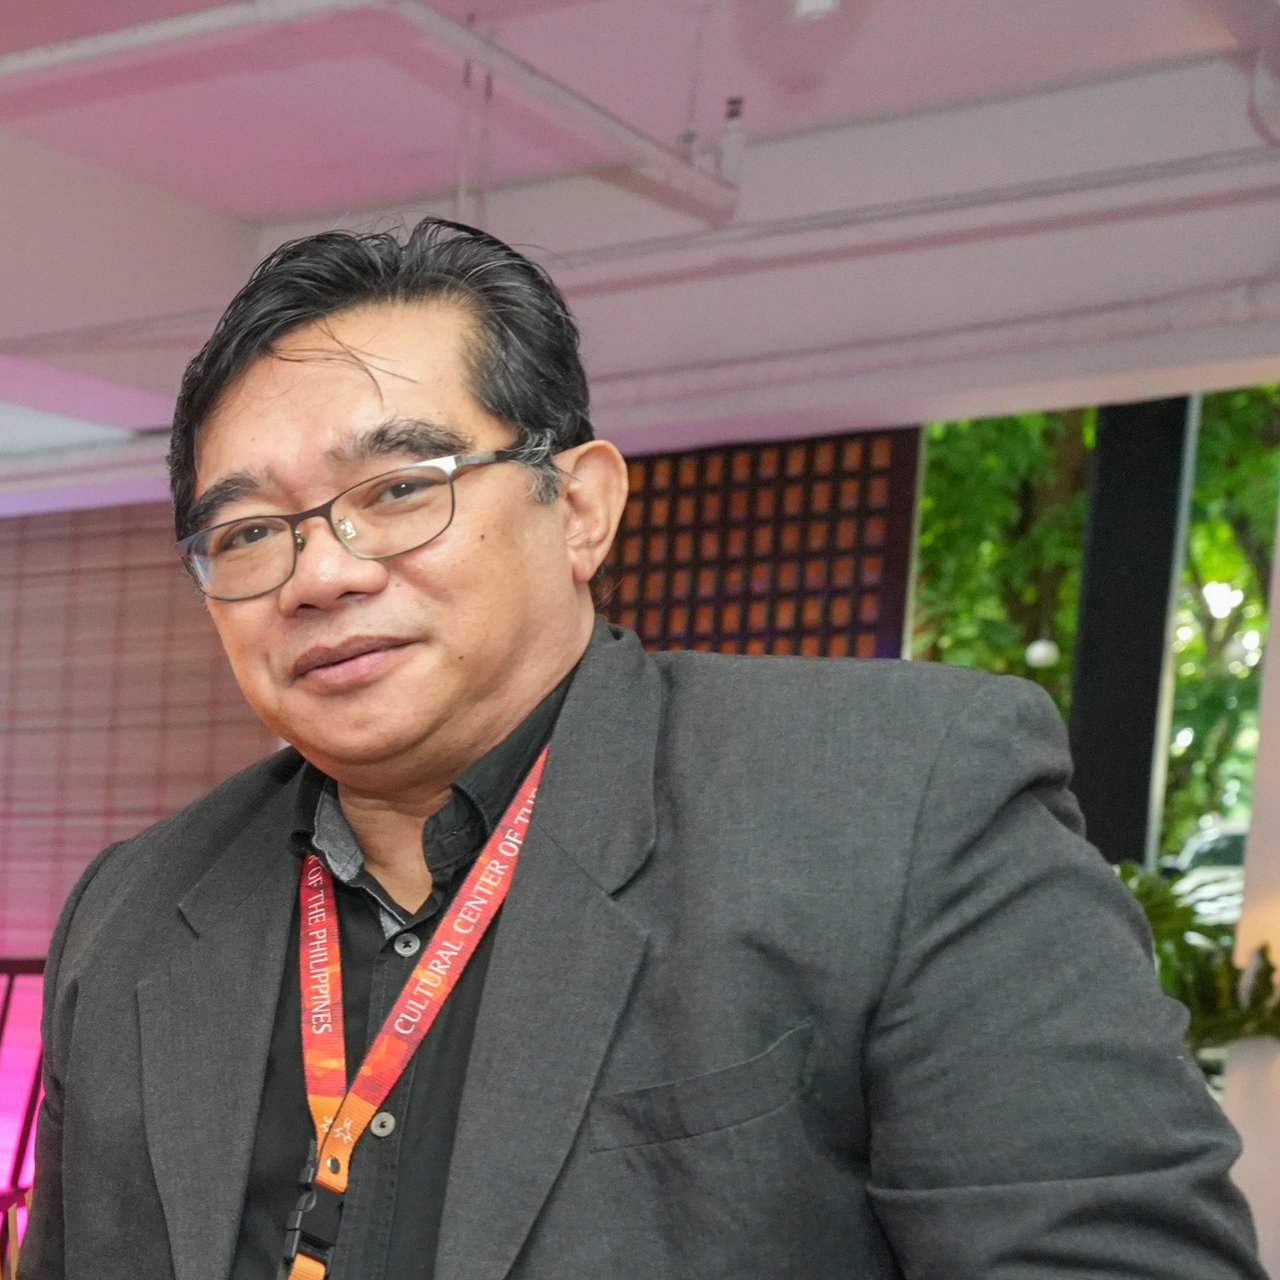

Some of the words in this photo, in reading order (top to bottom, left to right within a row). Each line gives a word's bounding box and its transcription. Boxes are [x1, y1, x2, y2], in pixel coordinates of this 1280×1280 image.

[307, 865, 324, 888] OF
[307, 889, 327, 926] THE
[393, 940, 464, 1035] CULTURAL
[452, 858, 509, 935] CENTER
[498, 828, 523, 857] OF
[308, 928, 333, 1035] PHILIPPINES
